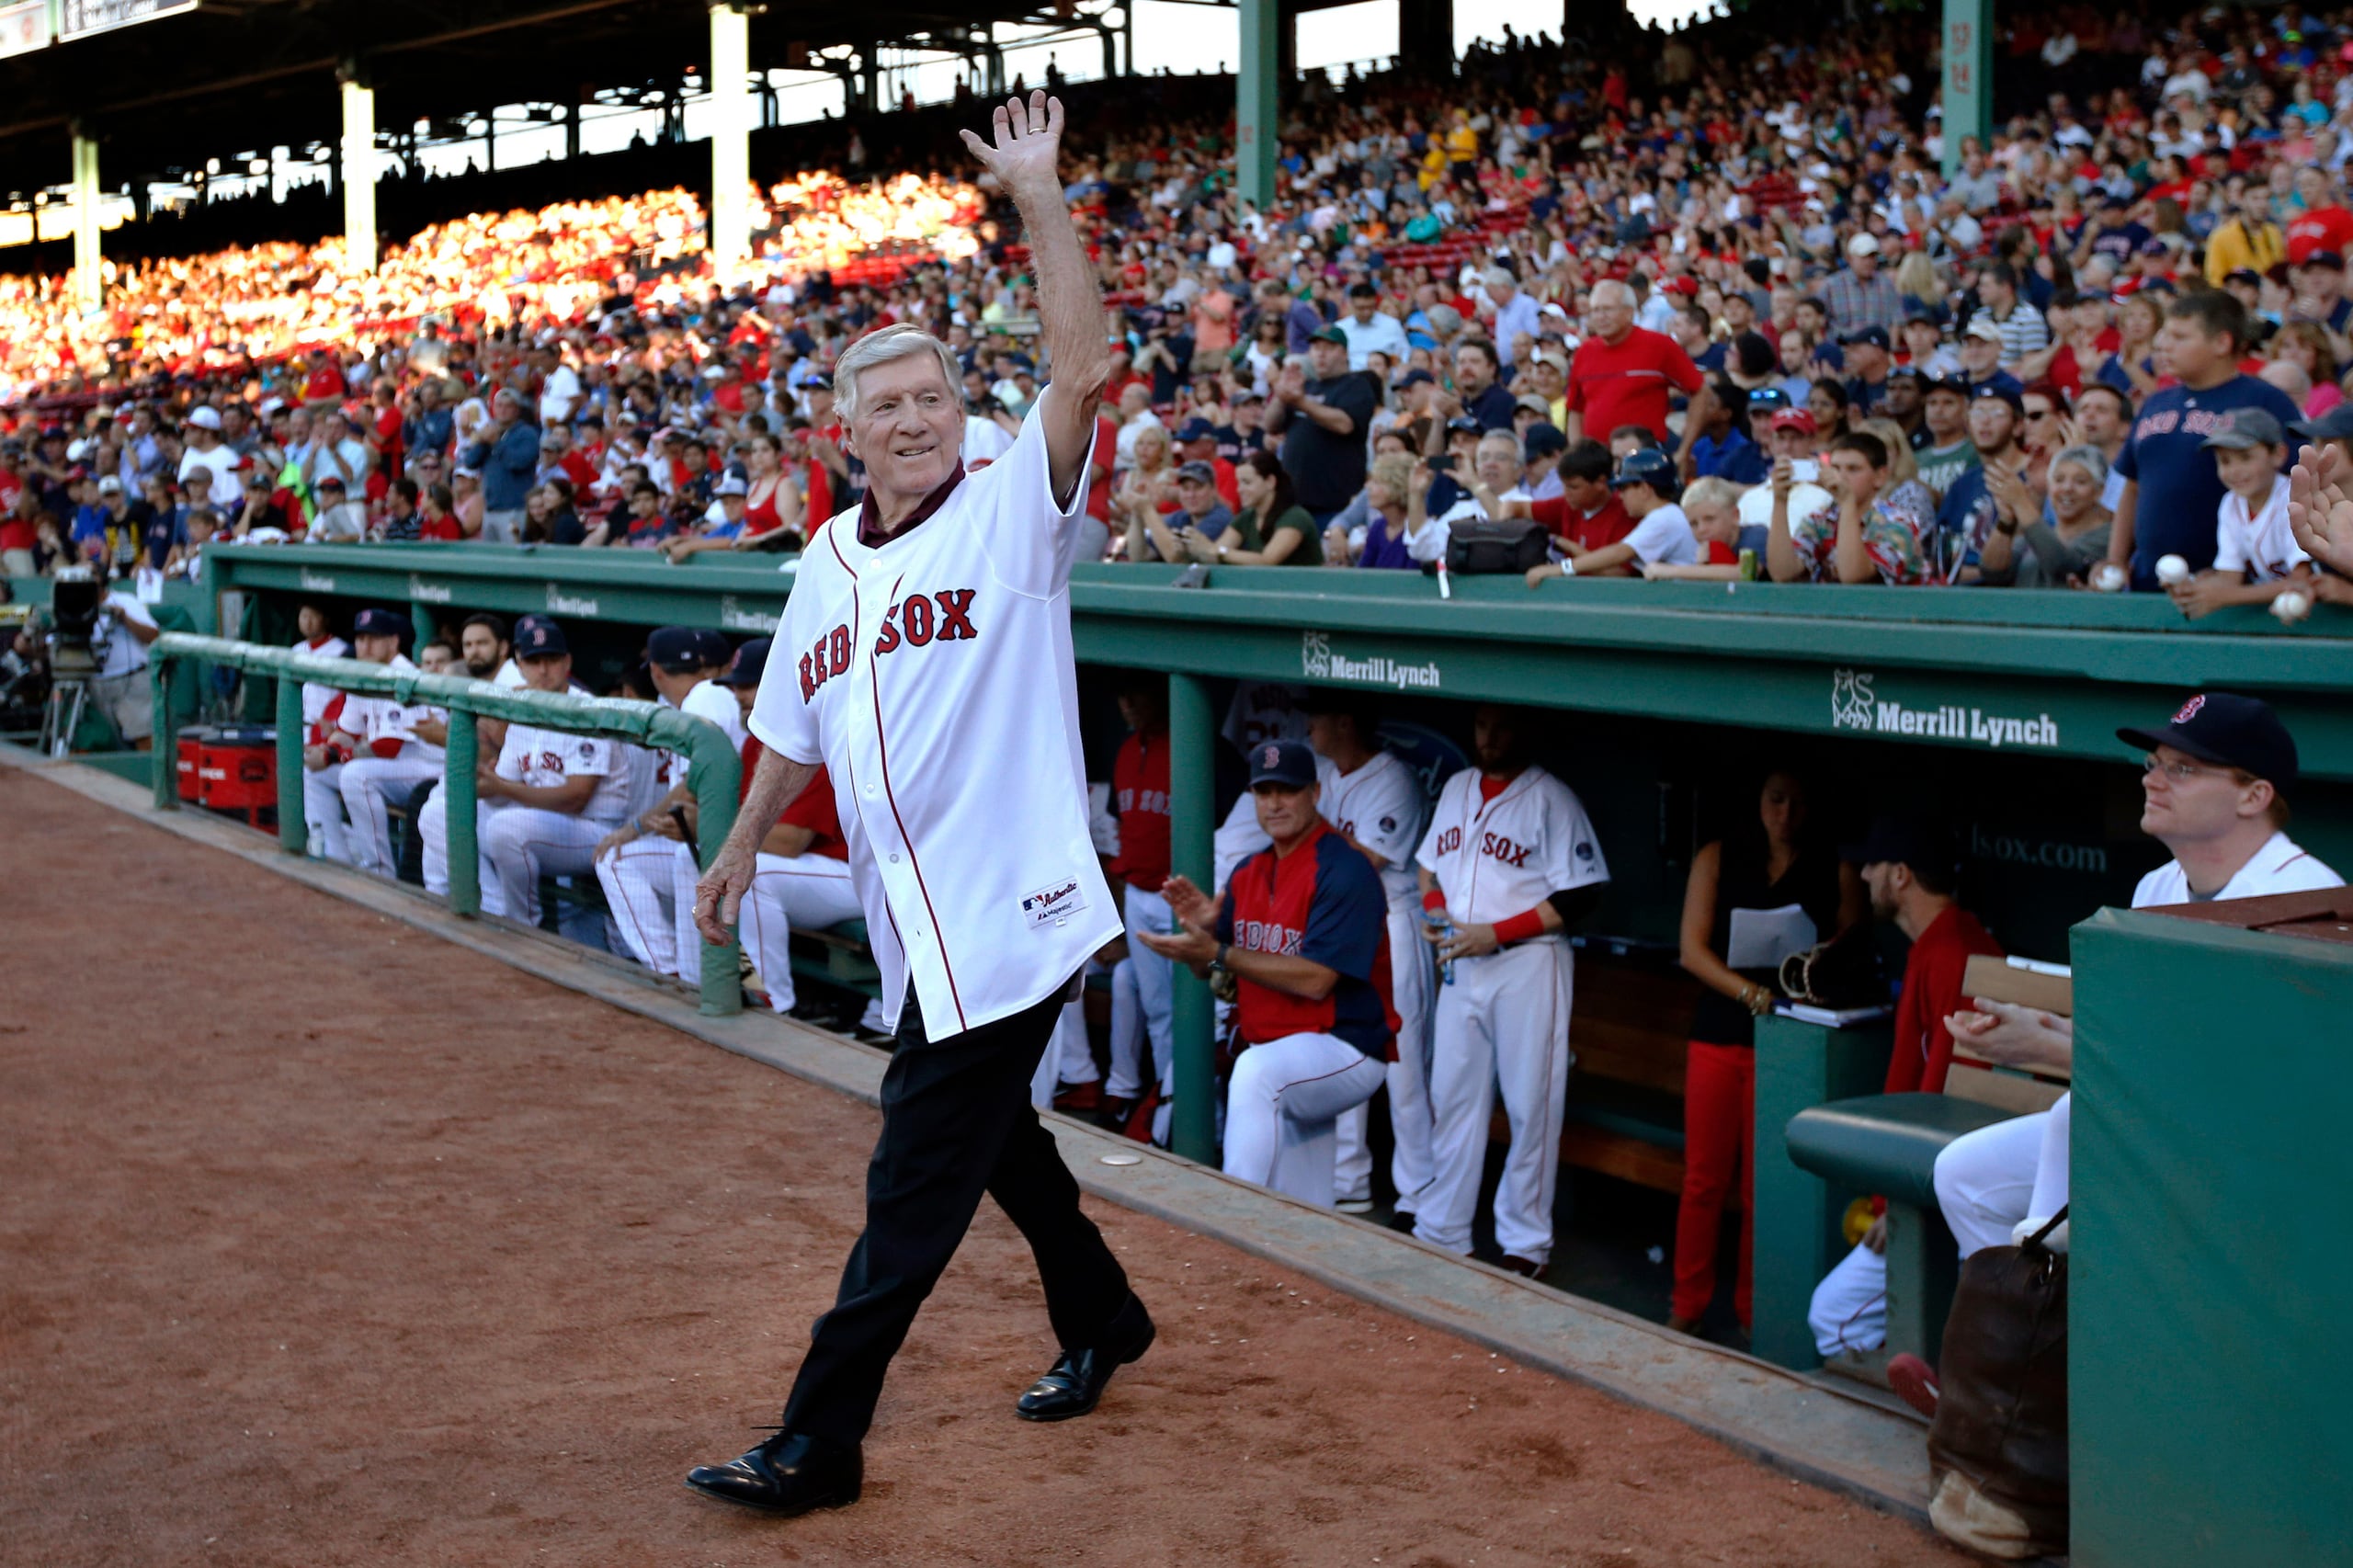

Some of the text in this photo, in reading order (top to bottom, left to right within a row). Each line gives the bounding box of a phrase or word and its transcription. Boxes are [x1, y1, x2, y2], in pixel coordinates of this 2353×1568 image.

[2135, 410, 2179, 441] RED
[799, 588, 979, 705] RED SOX
[1330, 654, 1439, 689] Merrill Lynch
[1876, 701, 2058, 747] Merrill Lynch
[1437, 825, 1531, 869] RED SOX
[1043, 882, 1077, 908] Authentic
[1047, 901, 1073, 915] Majestic
